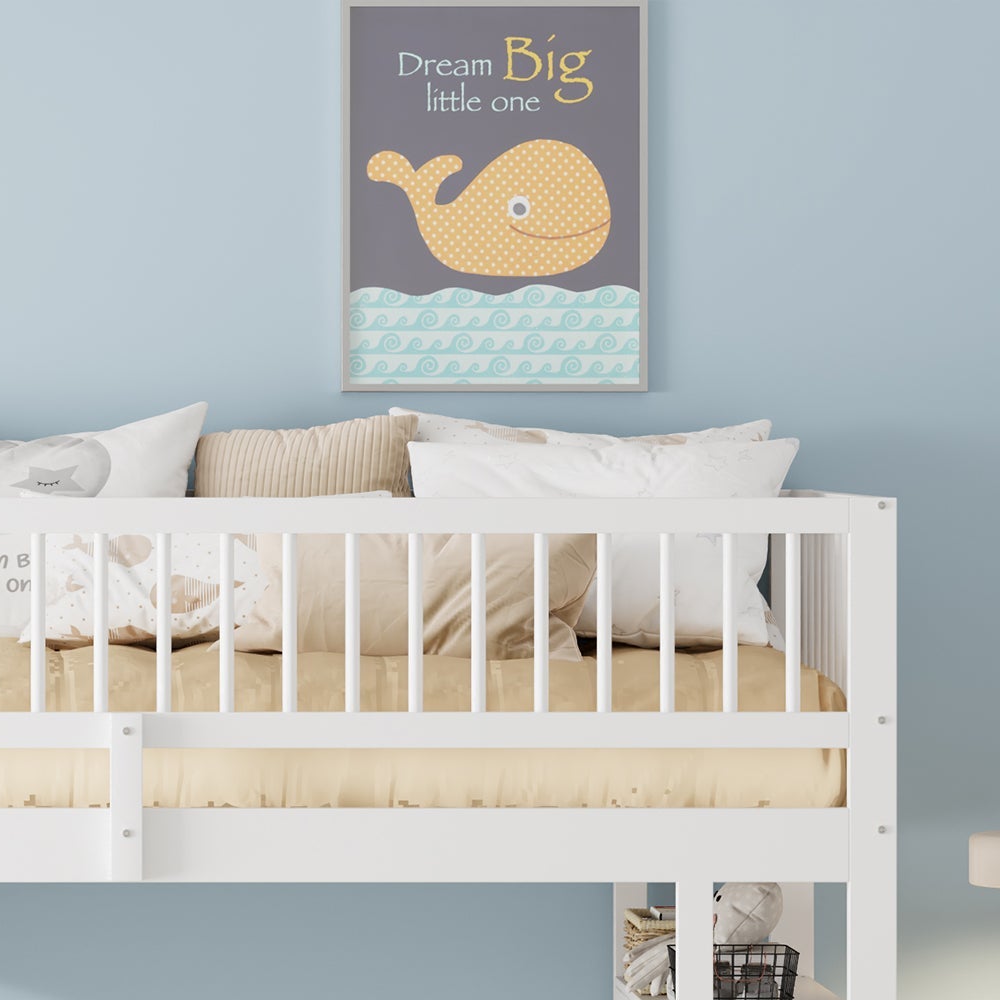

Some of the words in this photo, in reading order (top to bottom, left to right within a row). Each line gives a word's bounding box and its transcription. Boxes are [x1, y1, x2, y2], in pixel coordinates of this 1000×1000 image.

[397, 52, 493, 77] Dream
[503, 34, 594, 104] Big
[426, 82, 482, 112] little
[491, 95, 542, 112] one
